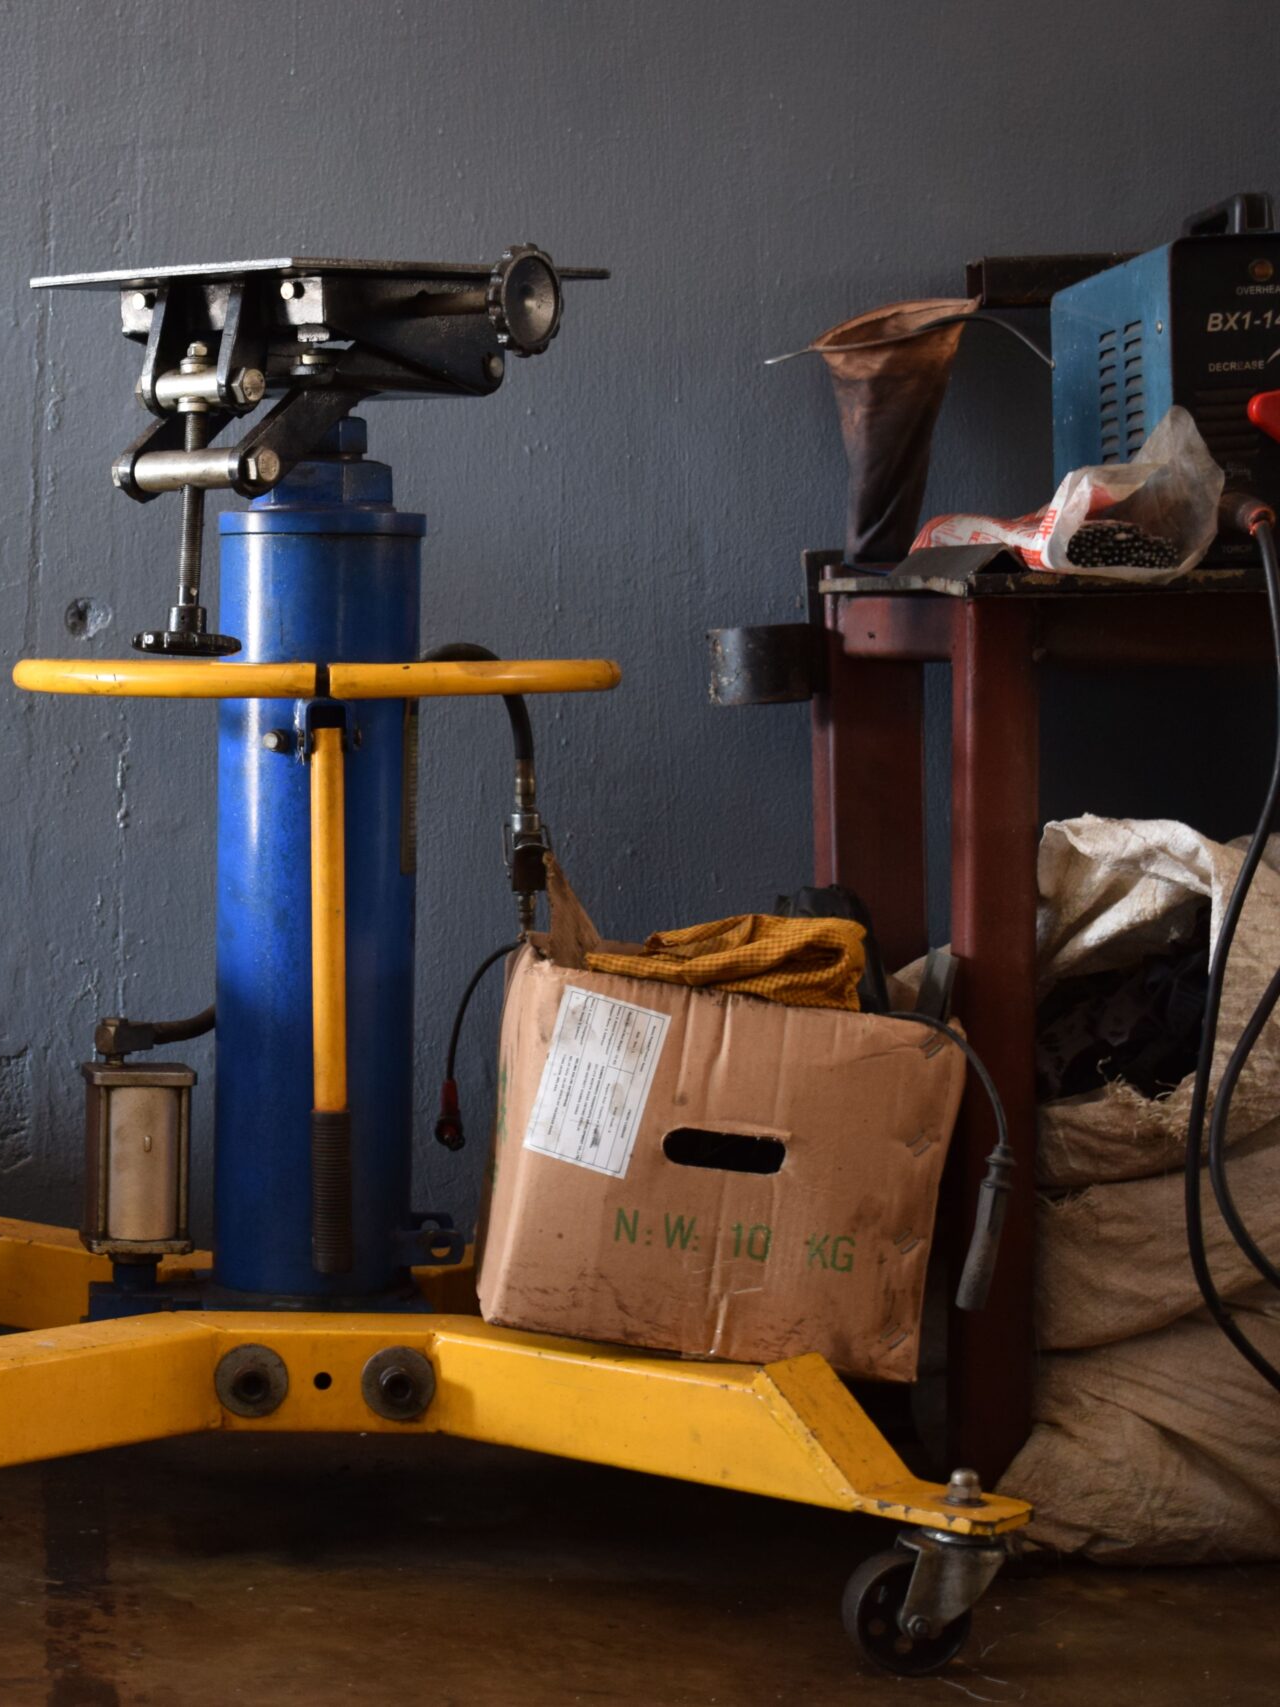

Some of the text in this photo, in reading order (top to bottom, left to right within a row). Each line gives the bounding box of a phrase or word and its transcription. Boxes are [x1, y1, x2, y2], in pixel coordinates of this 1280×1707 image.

[1208, 361, 1264, 372] DECREASE
[731, 1221, 771, 1263] 10
[806, 1231, 857, 1273] KG
